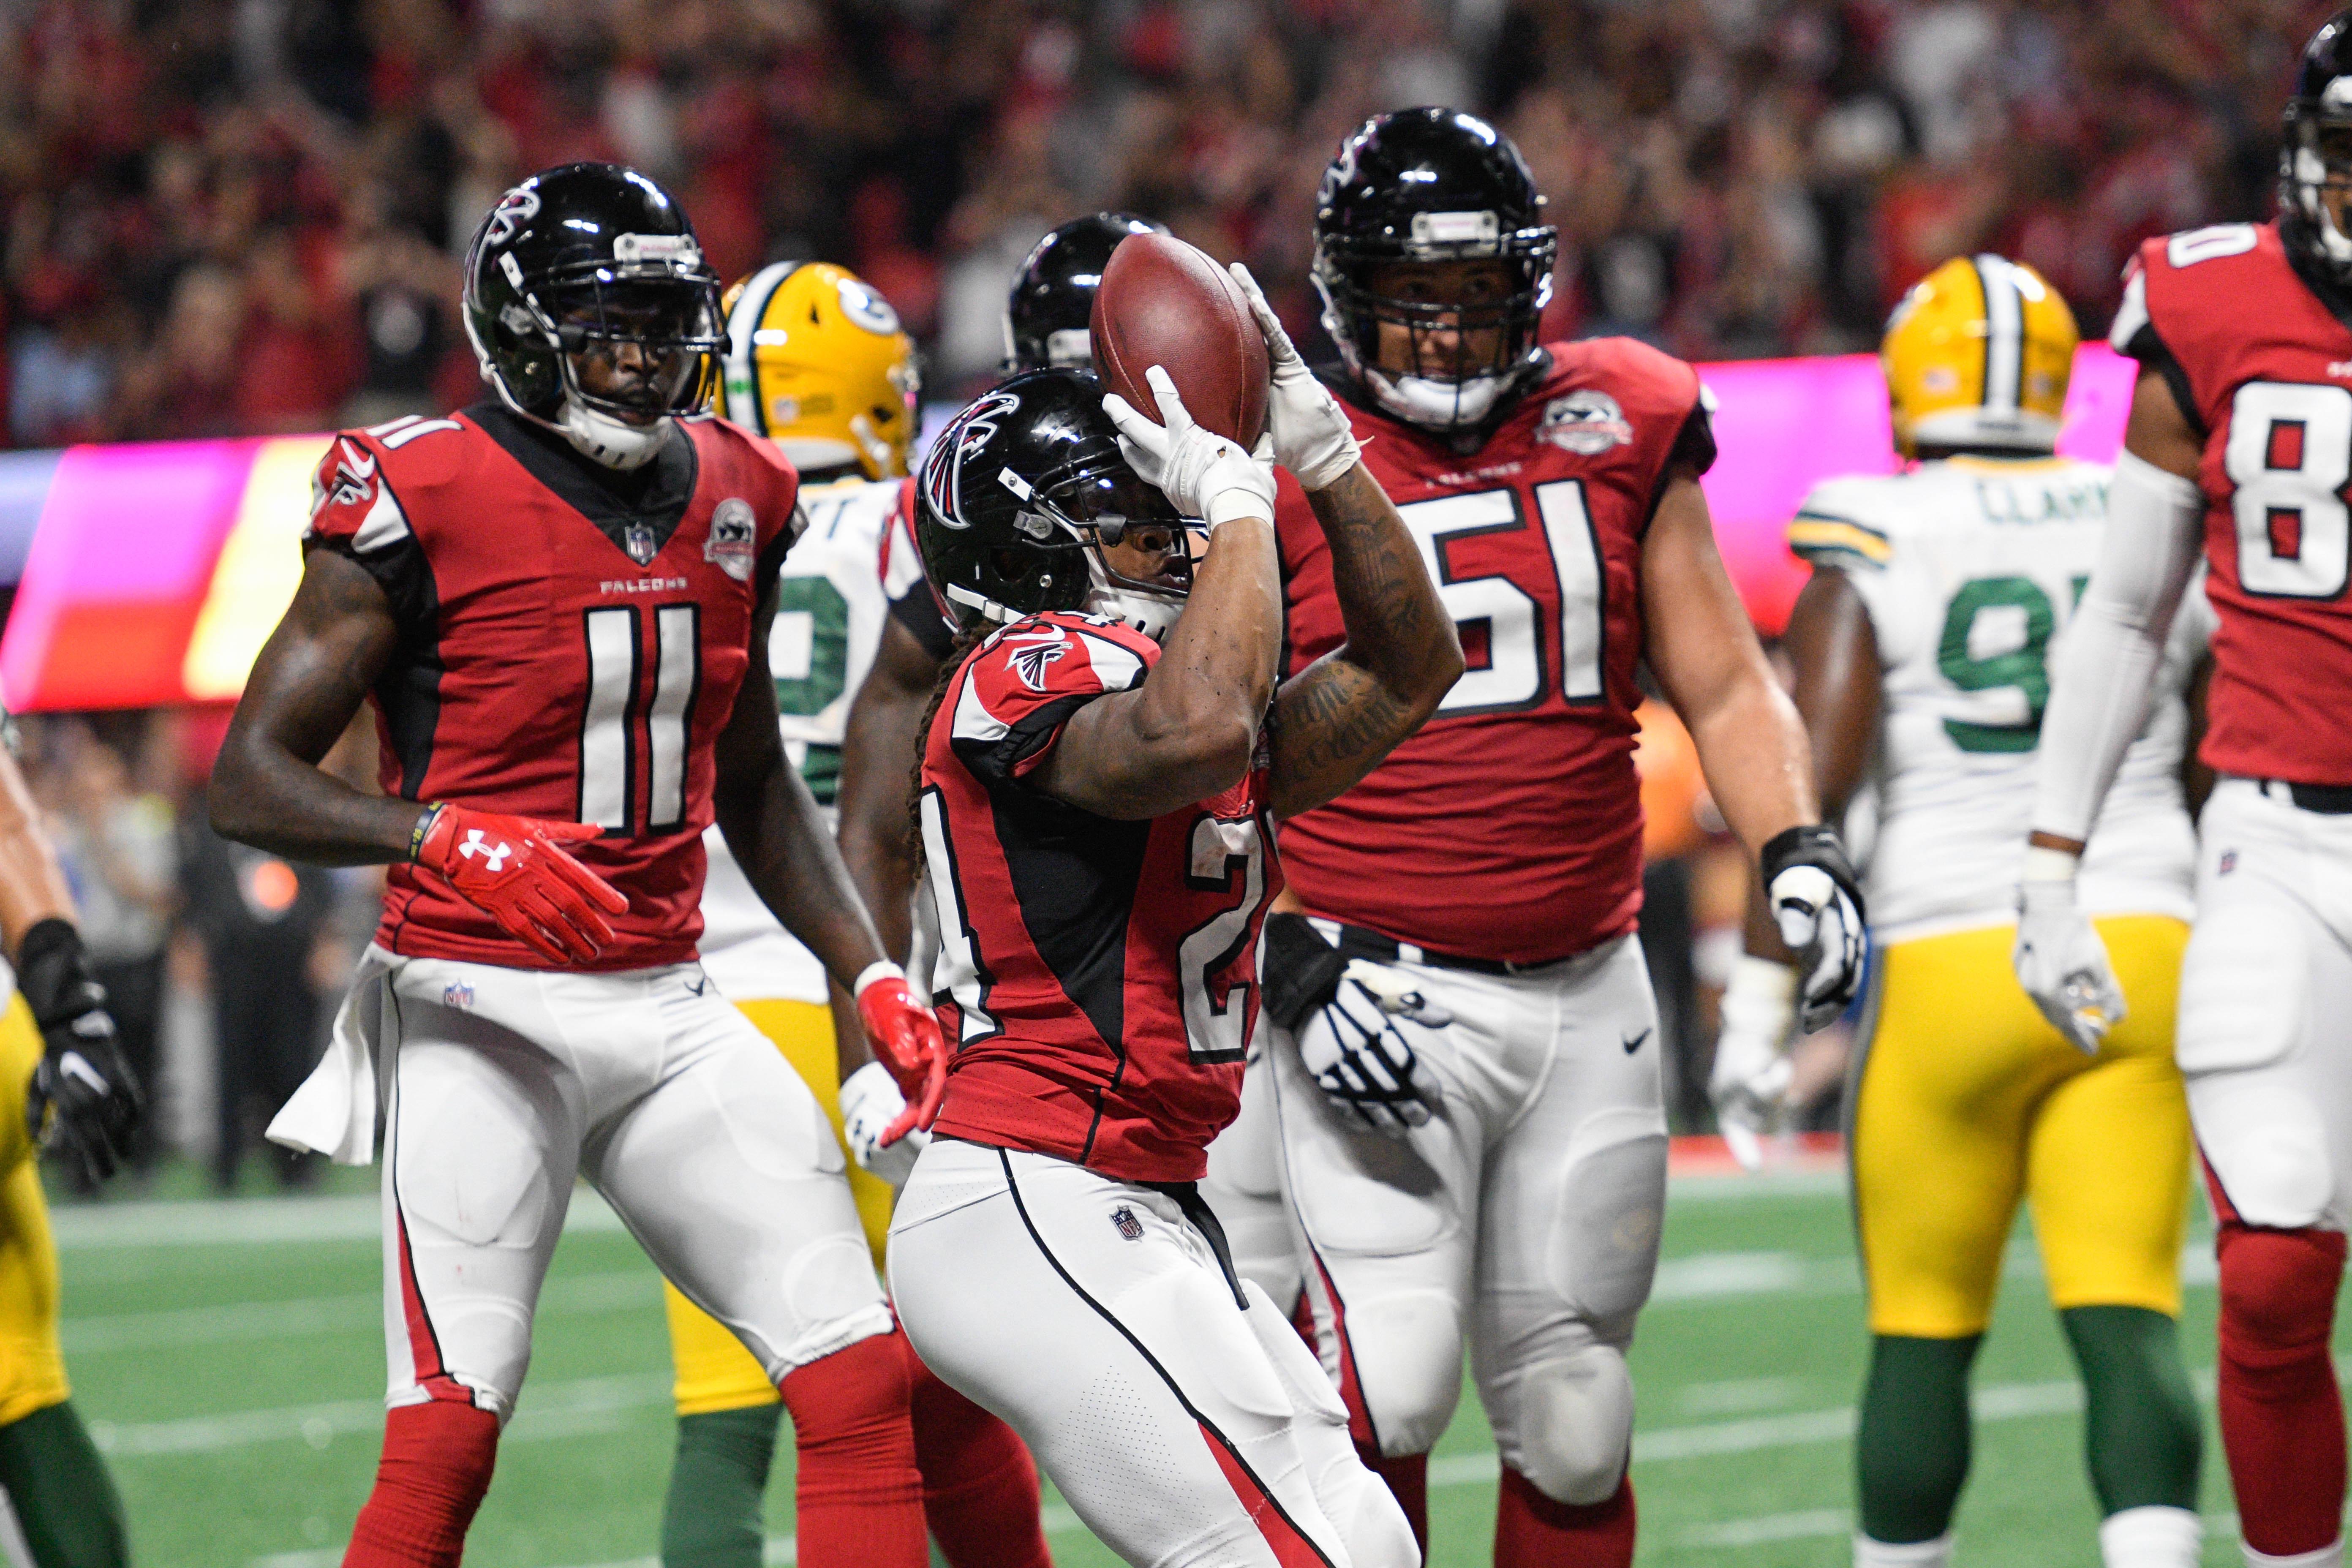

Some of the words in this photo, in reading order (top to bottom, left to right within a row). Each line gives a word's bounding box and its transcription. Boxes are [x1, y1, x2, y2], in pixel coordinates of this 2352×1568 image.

[600, 577, 688, 594] FALCONS
[1398, 477, 1605, 720] 51
[576, 602, 702, 839] 11
[1177, 814, 1267, 1064] 2
